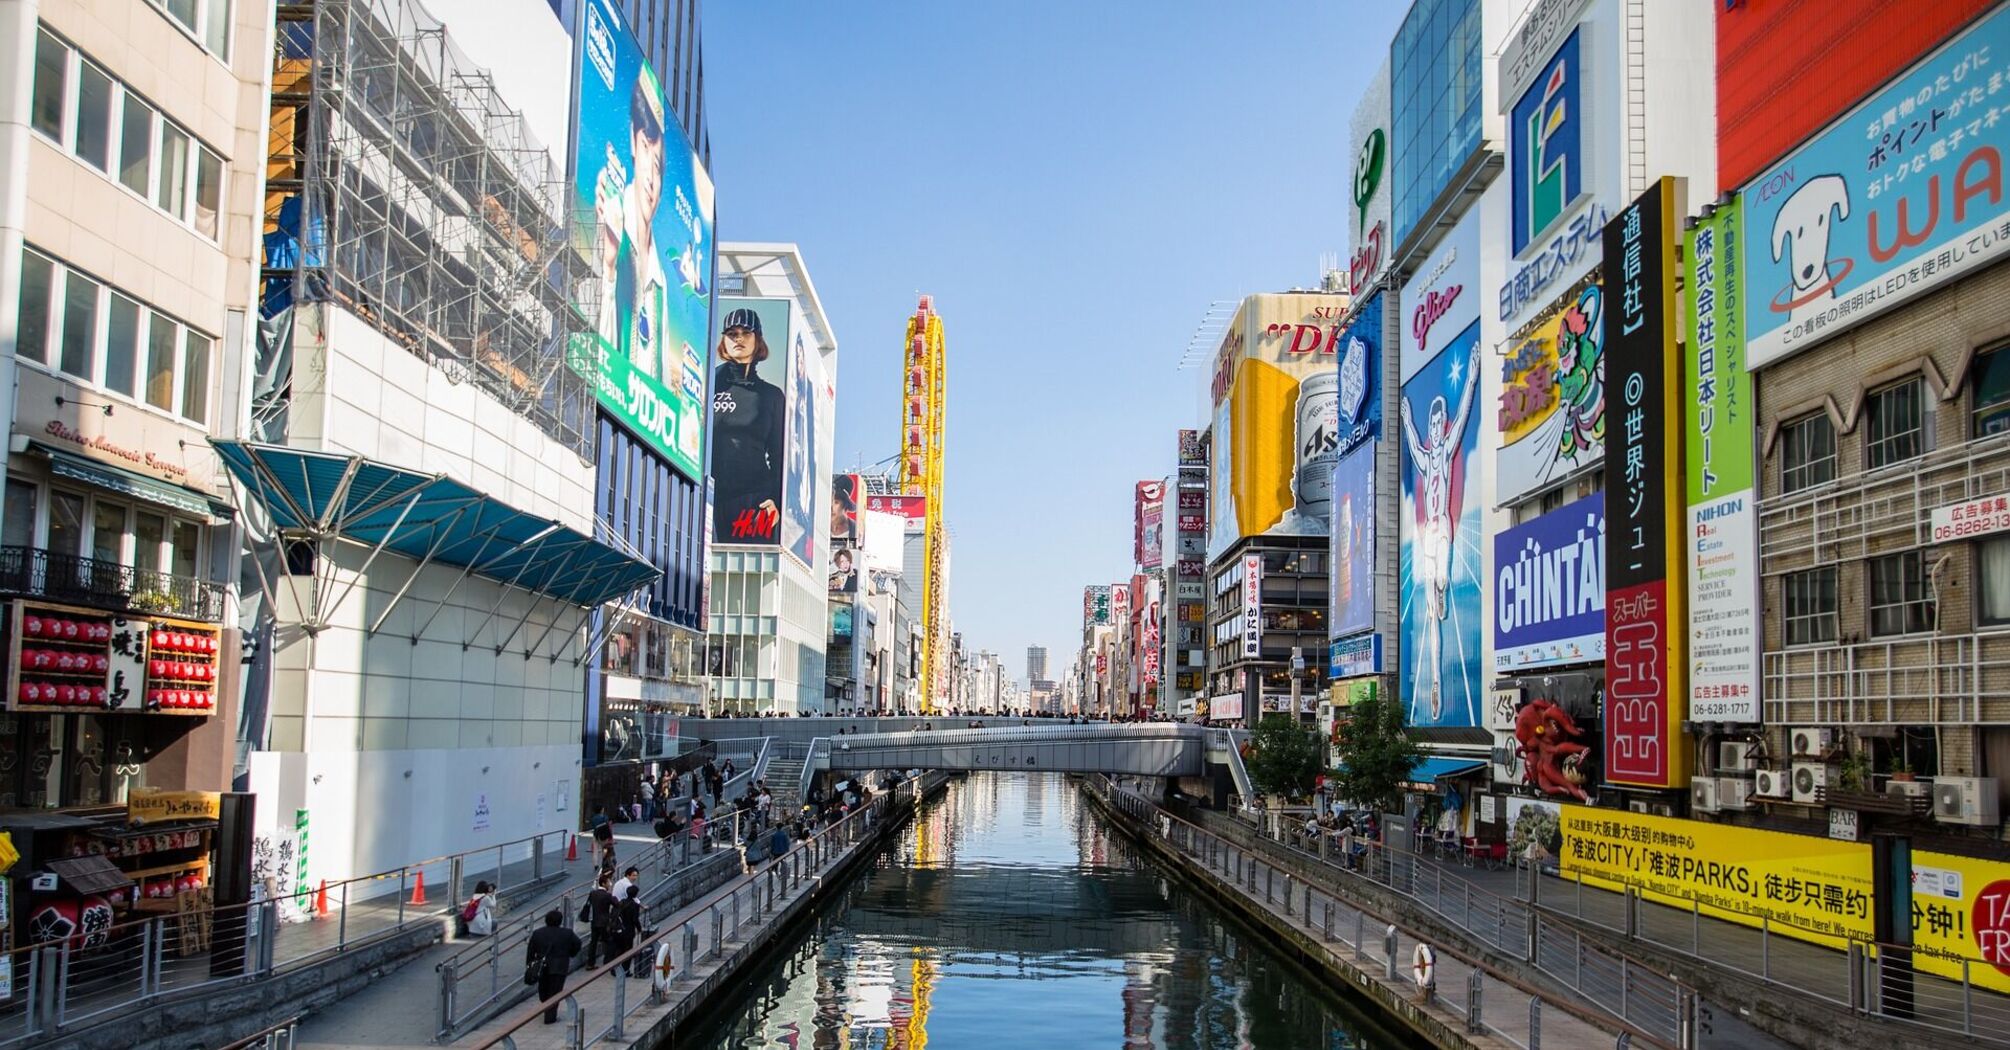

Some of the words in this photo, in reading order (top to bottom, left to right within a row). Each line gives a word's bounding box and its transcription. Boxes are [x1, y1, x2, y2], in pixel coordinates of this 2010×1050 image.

[1867, 46, 1991, 140] お買物のたびに
[1499, 203, 1608, 322] 日商エステム
[1412, 284, 1463, 351] Glico
[1695, 227, 1716, 495] 株式会社日本リート
[1696, 499, 1742, 523] NIHON
[1951, 497, 2008, 523] 広告募集
[731, 508, 777, 539] H&M
[1696, 523, 1717, 538] Real
[1697, 538, 1723, 553] Estate
[1696, 553, 1734, 568] Investment
[1696, 567, 1736, 581] Technology
[1697, 579, 1726, 592] SERVICE
[1697, 588, 1733, 602] PROVIDER
[1613, 591, 1658, 624] スーパー
[1694, 684, 1749, 698] 広告主募集中
[1694, 702, 1750, 715] 06-6281-1717
[1830, 810, 1856, 826] BAR
[1775, 909, 1792, 922] walk
[1793, 913, 1811, 928] from
[1811, 917, 1832, 932] here!
[1833, 923, 1846, 937] We
